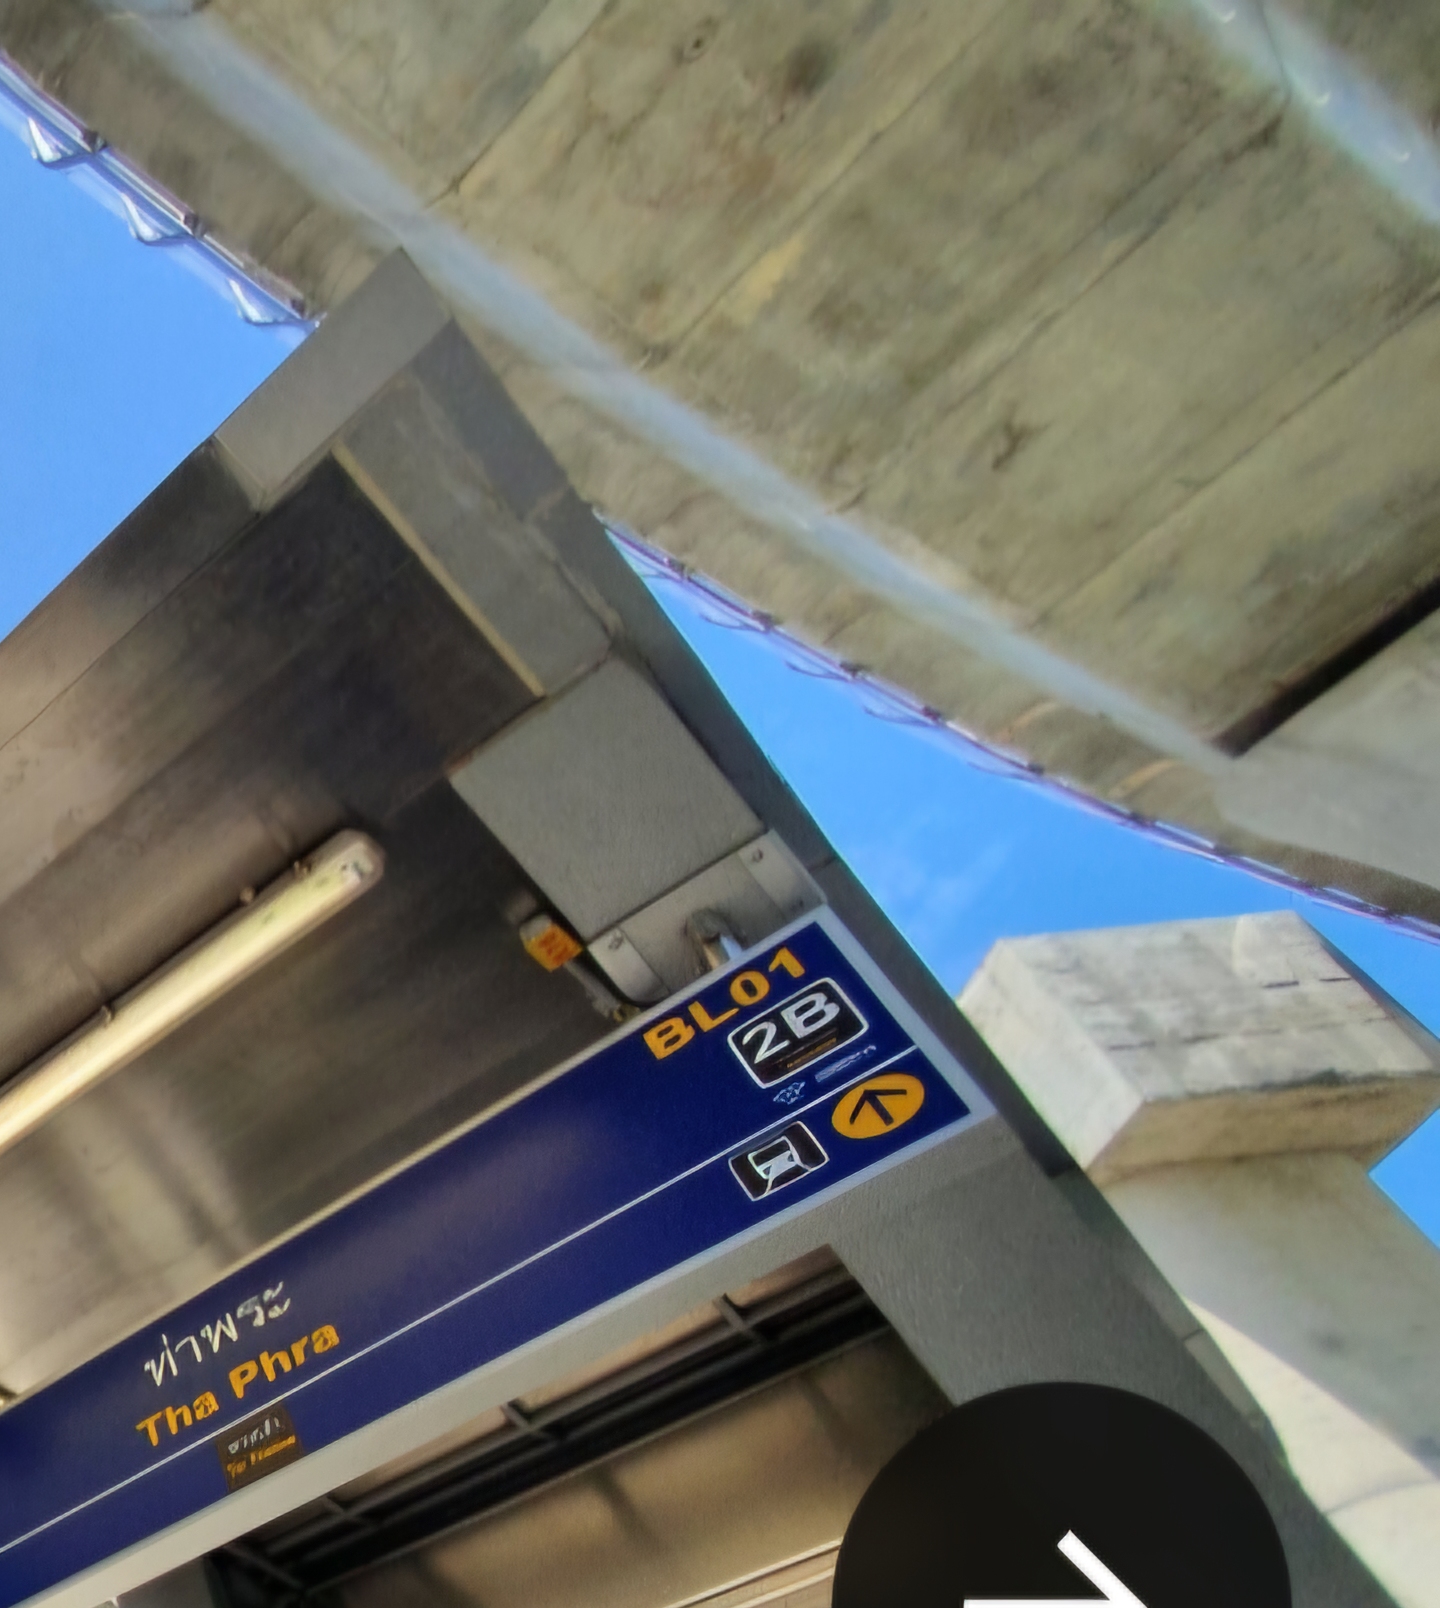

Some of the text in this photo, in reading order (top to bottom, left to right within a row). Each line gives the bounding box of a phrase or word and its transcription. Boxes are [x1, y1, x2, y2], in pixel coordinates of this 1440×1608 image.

[642, 947, 806, 1060] BL01
[742, 992, 840, 1065] 2B
[135, 1391, 219, 1447] Tha
[228, 1324, 340, 1399] Phra
[143, 1281, 291, 1387] ท่าพระ
